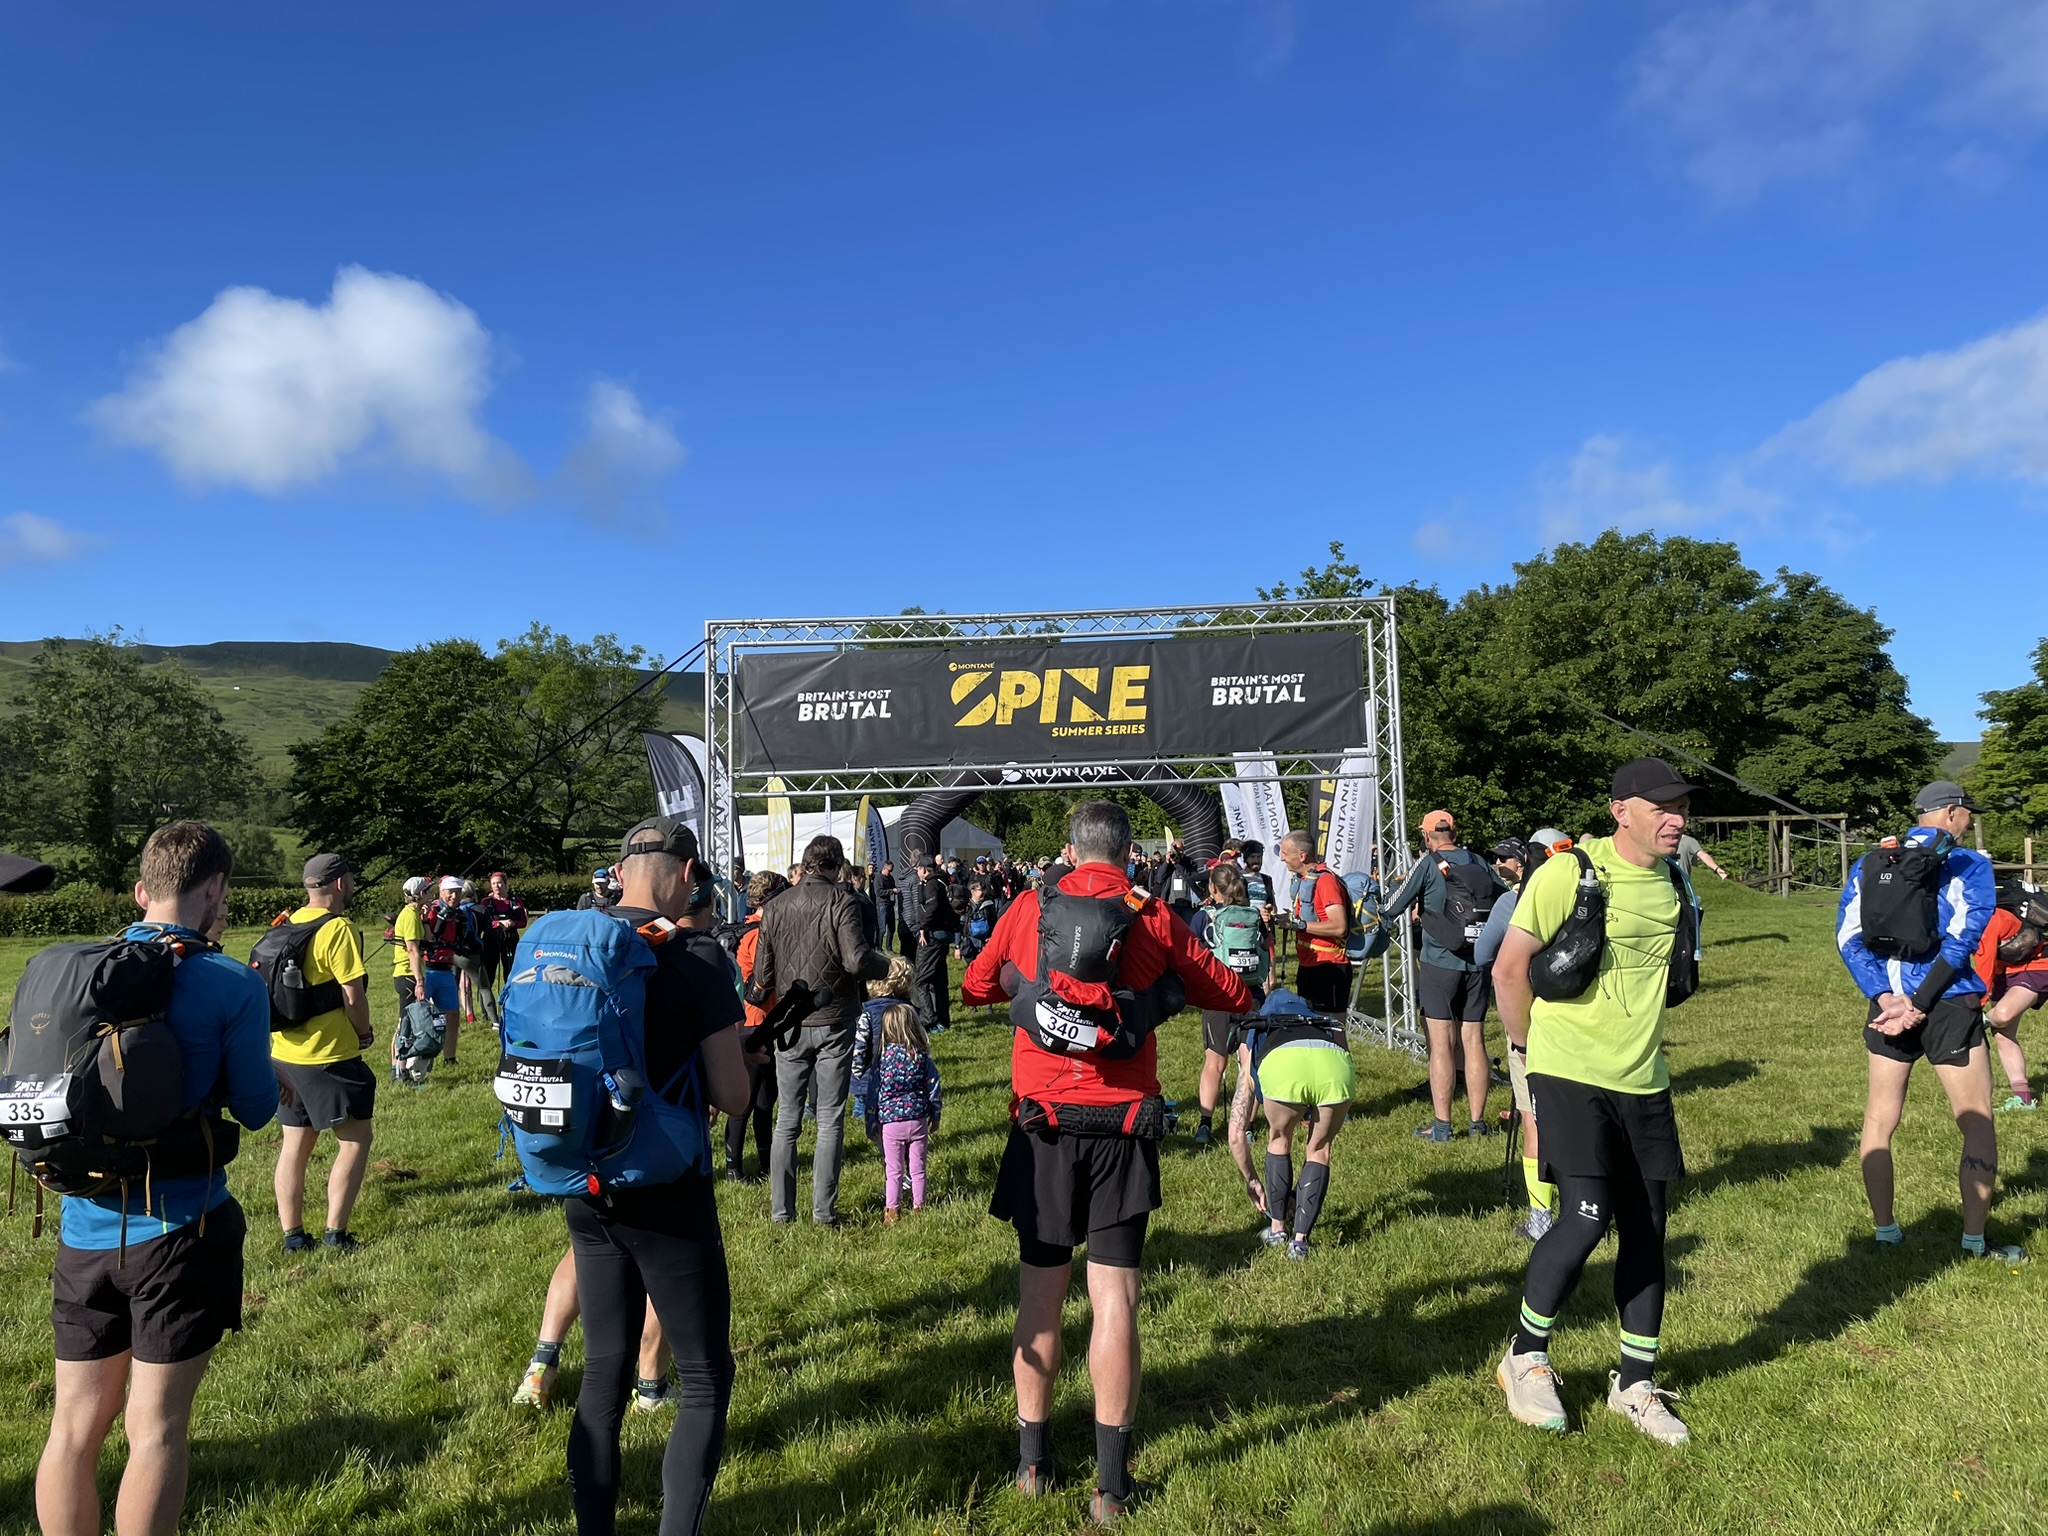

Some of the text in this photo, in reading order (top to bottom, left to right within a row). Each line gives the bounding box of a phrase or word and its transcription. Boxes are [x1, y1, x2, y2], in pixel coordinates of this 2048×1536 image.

[958, 662, 994, 670] MONTANE
[1211, 673, 1305, 687] BRITAIN'S MOST
[797, 689, 891, 702] BRITAIN'S MOST
[951, 665, 1150, 727] SPINE
[1211, 684, 1306, 706] BRUTAL
[798, 700, 892, 722] BRUTAL
[1051, 723, 1146, 738] SUMMER SERIES
[543, 951, 578, 960] MONTANE
[1069, 925, 1082, 970] SALOMON
[1047, 1016, 1079, 1040] 340
[513, 1083, 547, 1105] 373
[8, 1102, 45, 1121] 335
